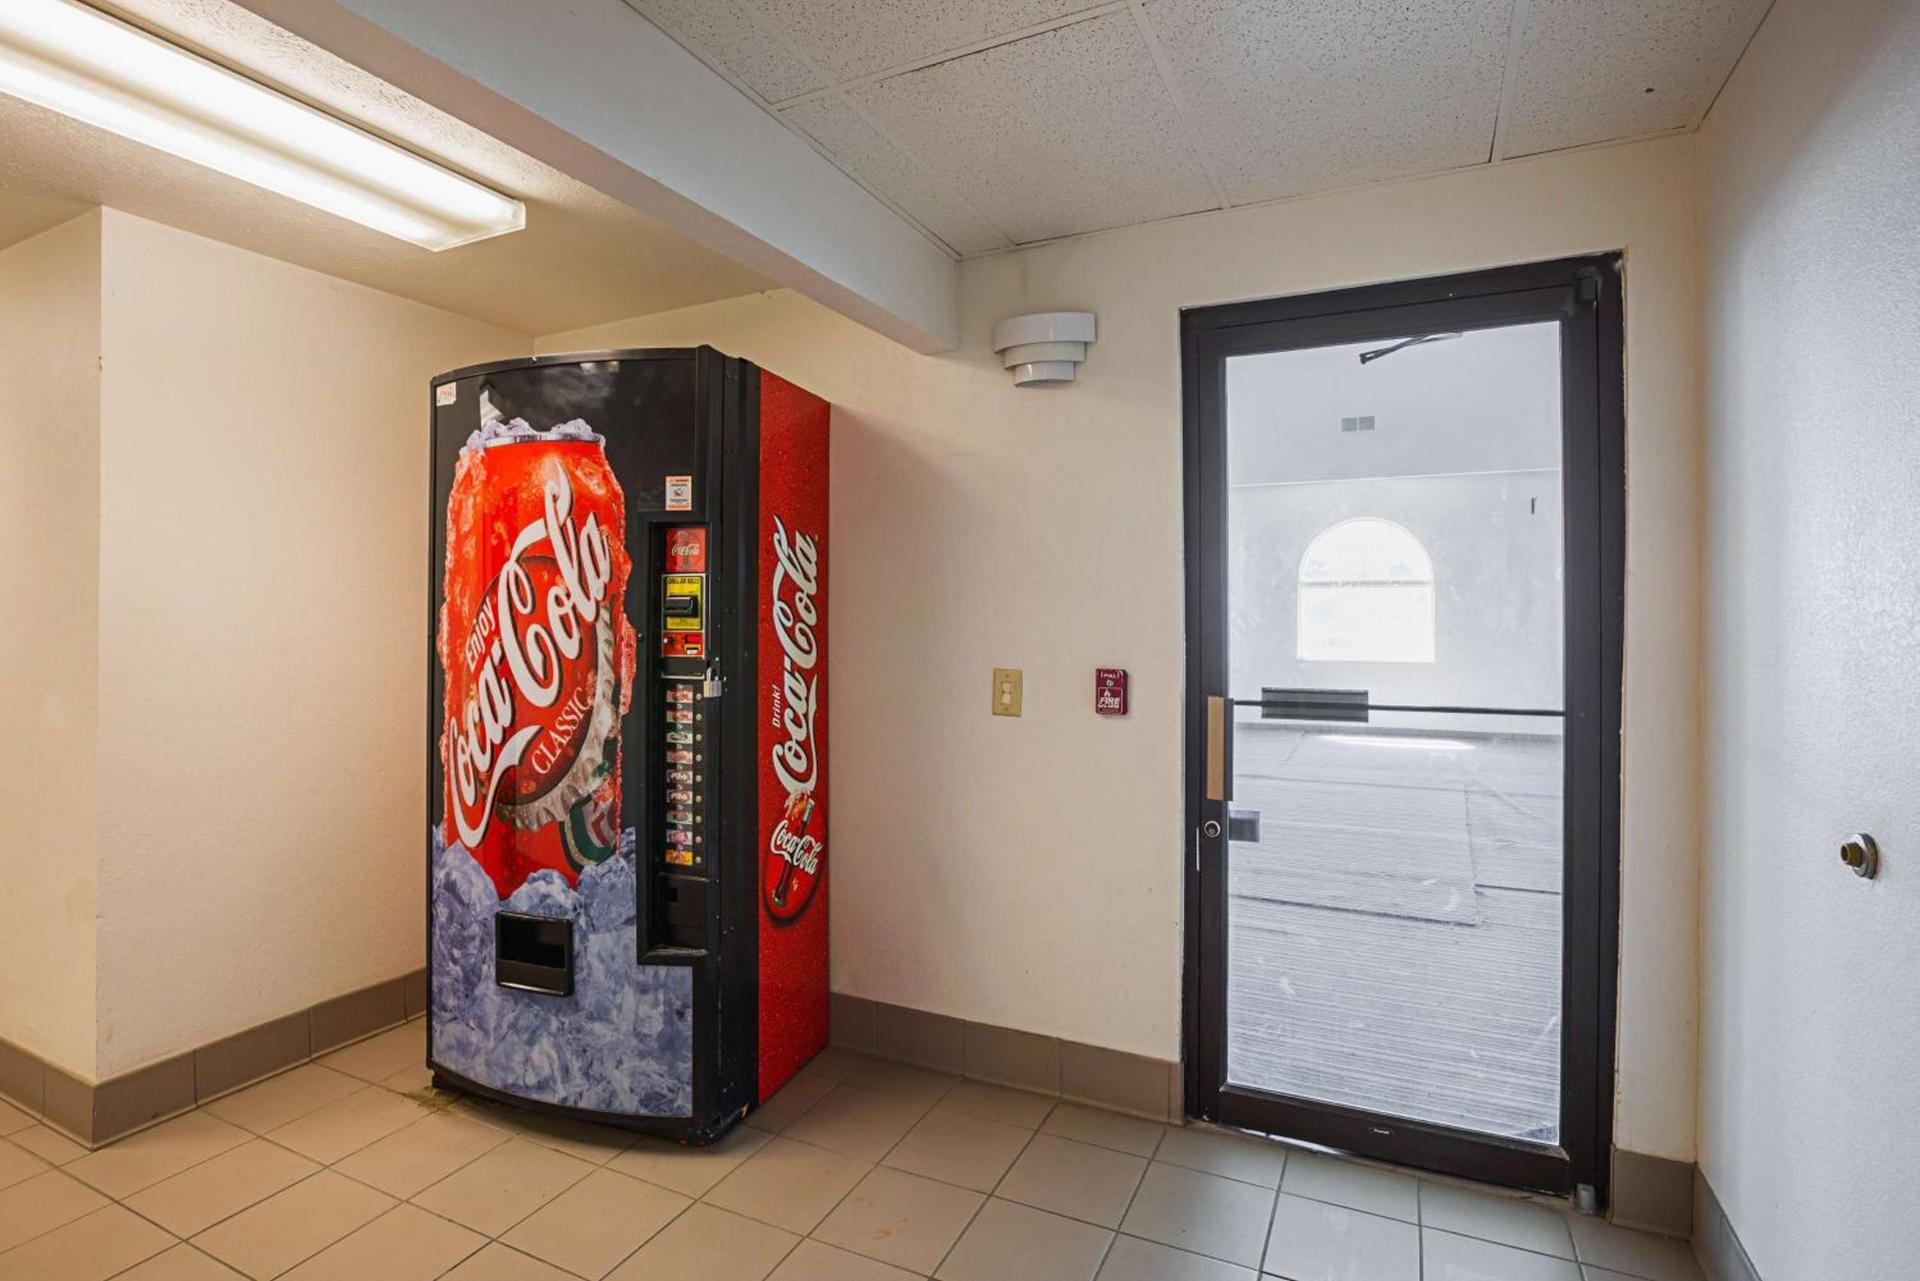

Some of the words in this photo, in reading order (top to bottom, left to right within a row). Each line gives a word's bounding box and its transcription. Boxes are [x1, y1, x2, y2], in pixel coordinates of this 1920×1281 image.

[450, 457, 612, 848] Coca-Cola
[465, 596, 497, 672] Enjoy
[772, 513, 818, 797] Coca-Cola
[531, 686, 593, 775] CLASSIC
[1099, 697, 1121, 706] FIRE
